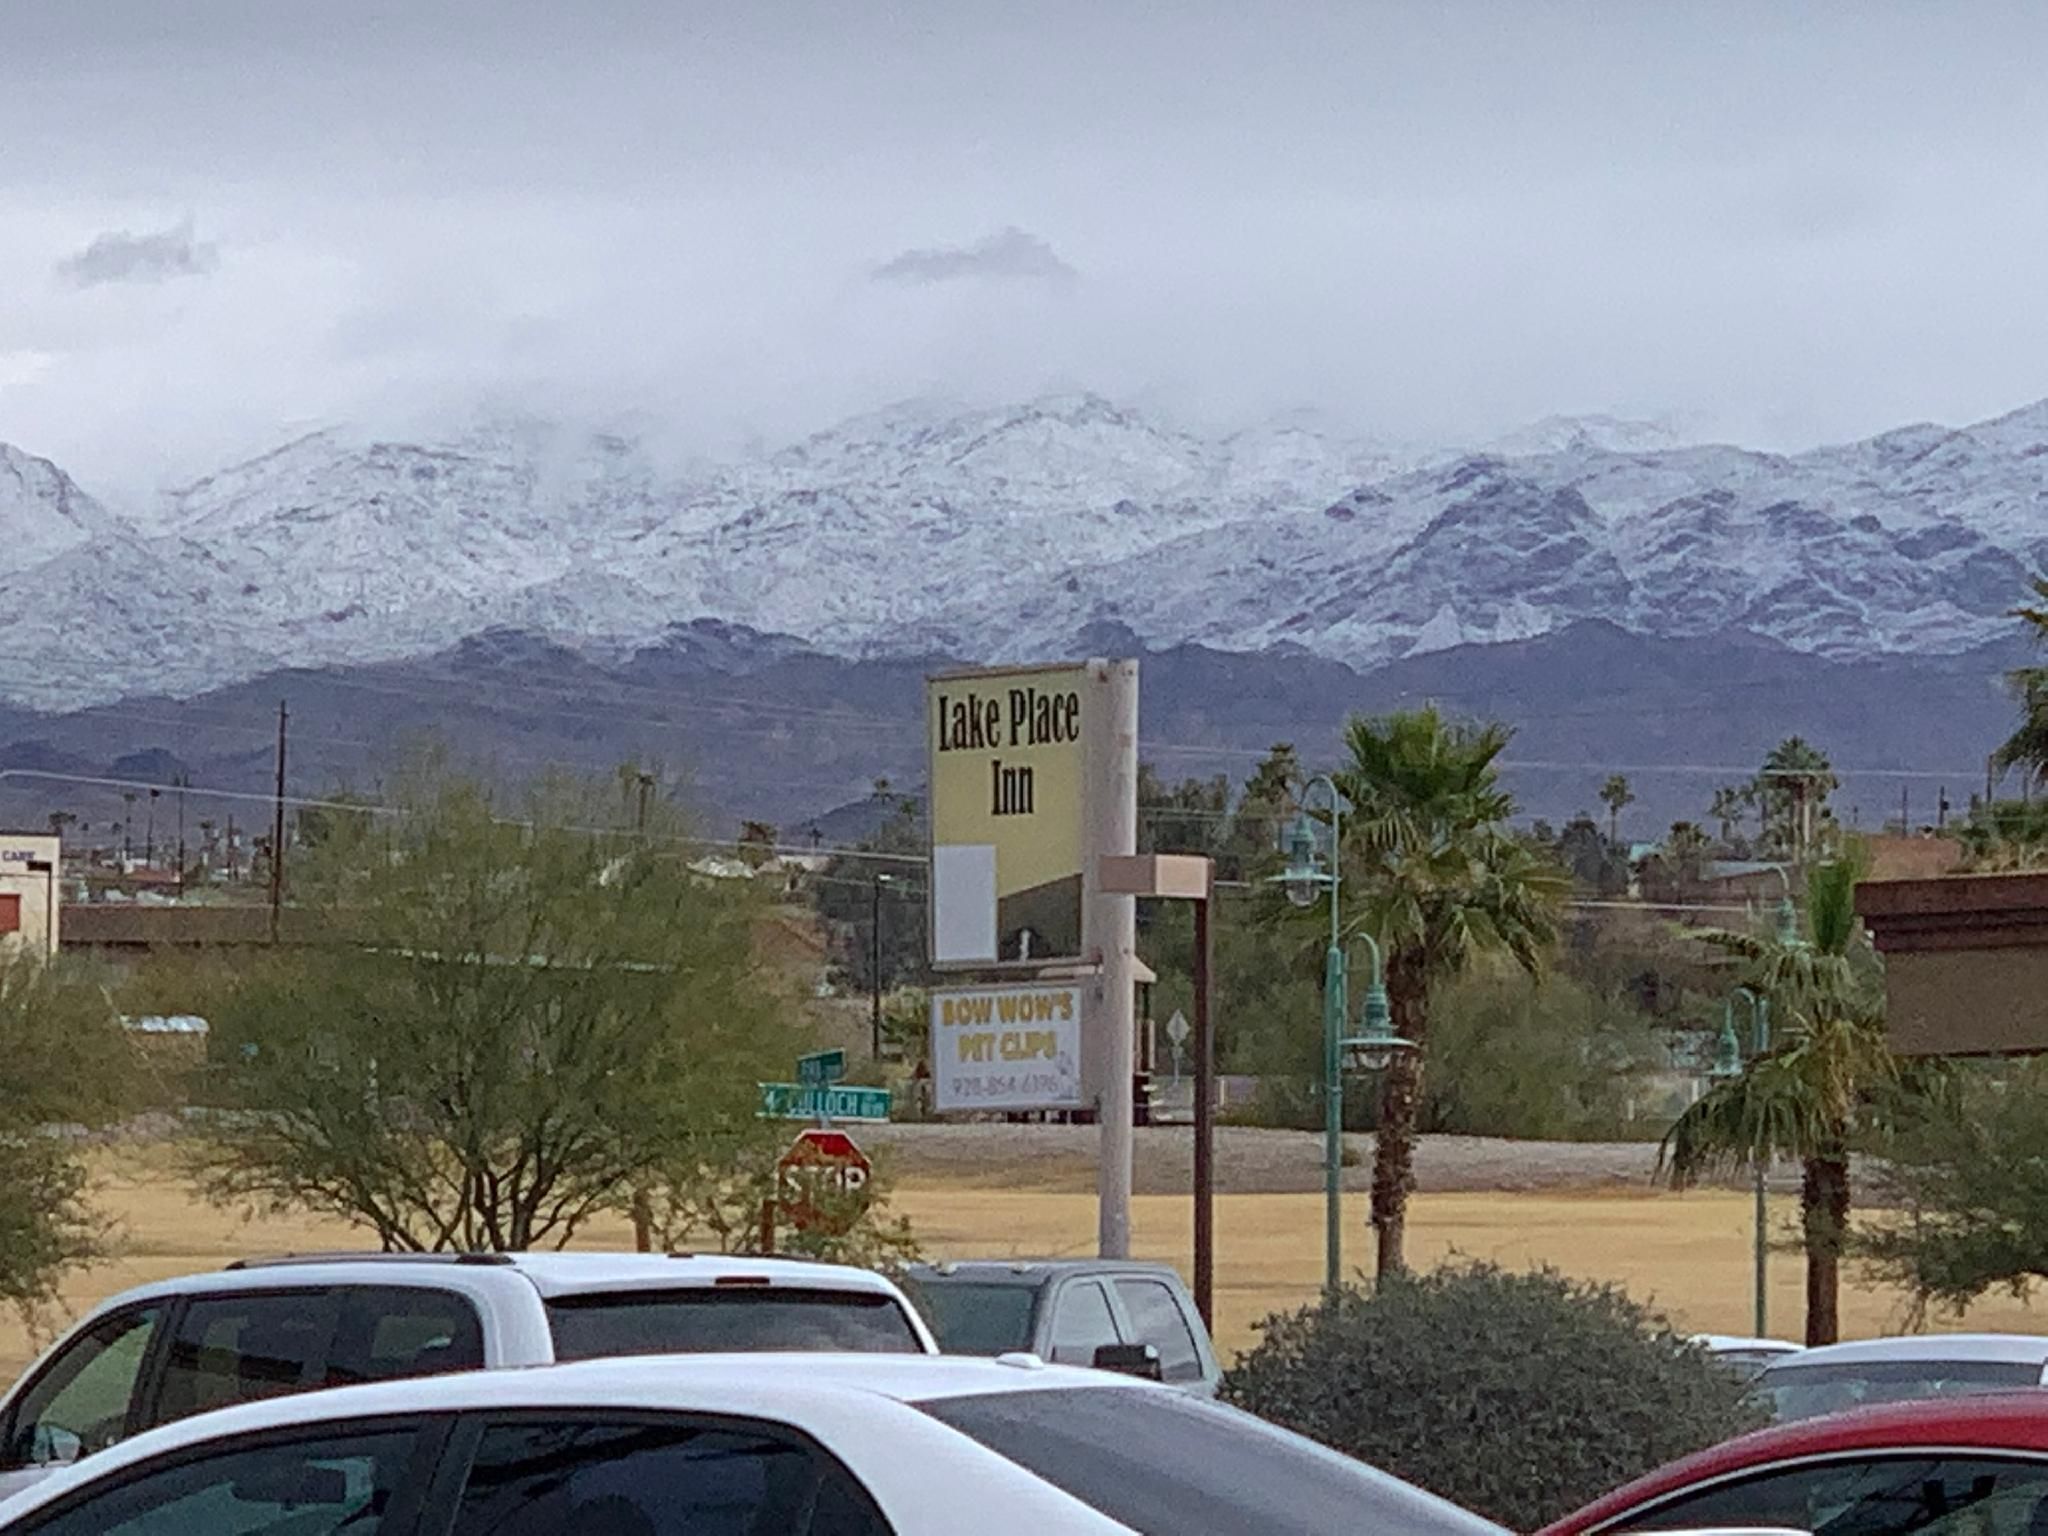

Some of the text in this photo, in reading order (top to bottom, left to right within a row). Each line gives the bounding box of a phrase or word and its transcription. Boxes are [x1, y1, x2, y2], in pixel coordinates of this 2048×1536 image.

[938, 687, 1080, 751] Lake Place
[991, 759, 1034, 816] Inn
[942, 991, 1074, 1027] BOW WOW'S
